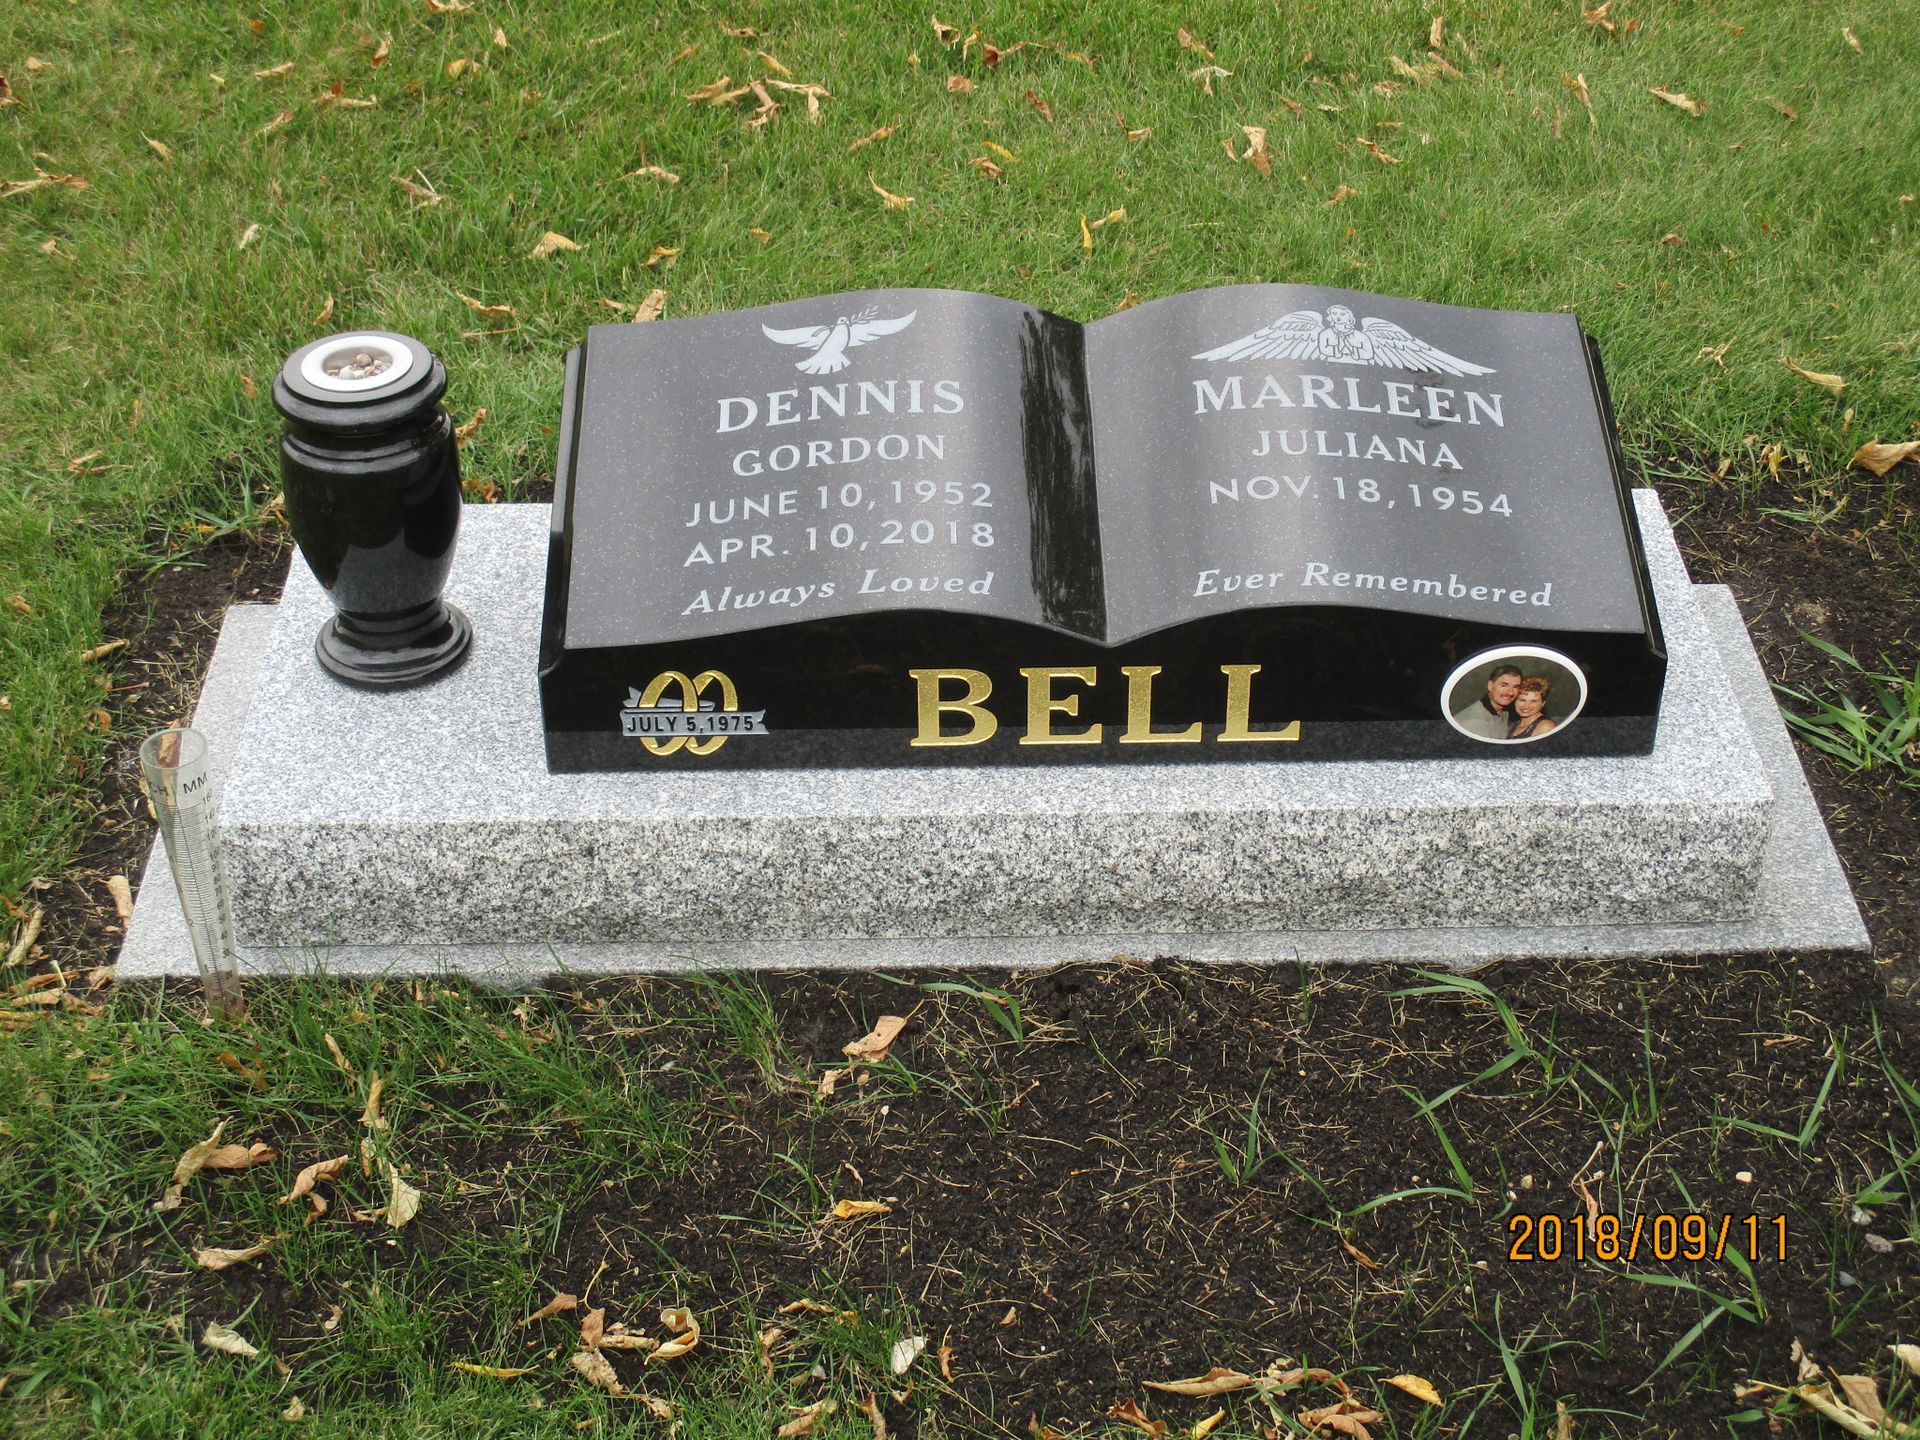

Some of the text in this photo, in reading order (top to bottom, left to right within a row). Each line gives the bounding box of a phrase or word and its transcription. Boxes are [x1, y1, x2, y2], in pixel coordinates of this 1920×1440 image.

[716, 379, 964, 433] DENNIS
[1193, 374, 1505, 428] MARLEEN
[732, 434, 946, 476] GORDON
[1251, 429, 1464, 470] JULIANA
[685, 489, 799, 528] JUNE
[683, 533, 790, 567] APR.
[681, 568, 996, 616] Always Loved
[1193, 561, 1553, 607] Ever Remembered
[627, 716, 677, 732] JULY
[908, 664, 1301, 747] BELL
[182, 771, 208, 794] MM
